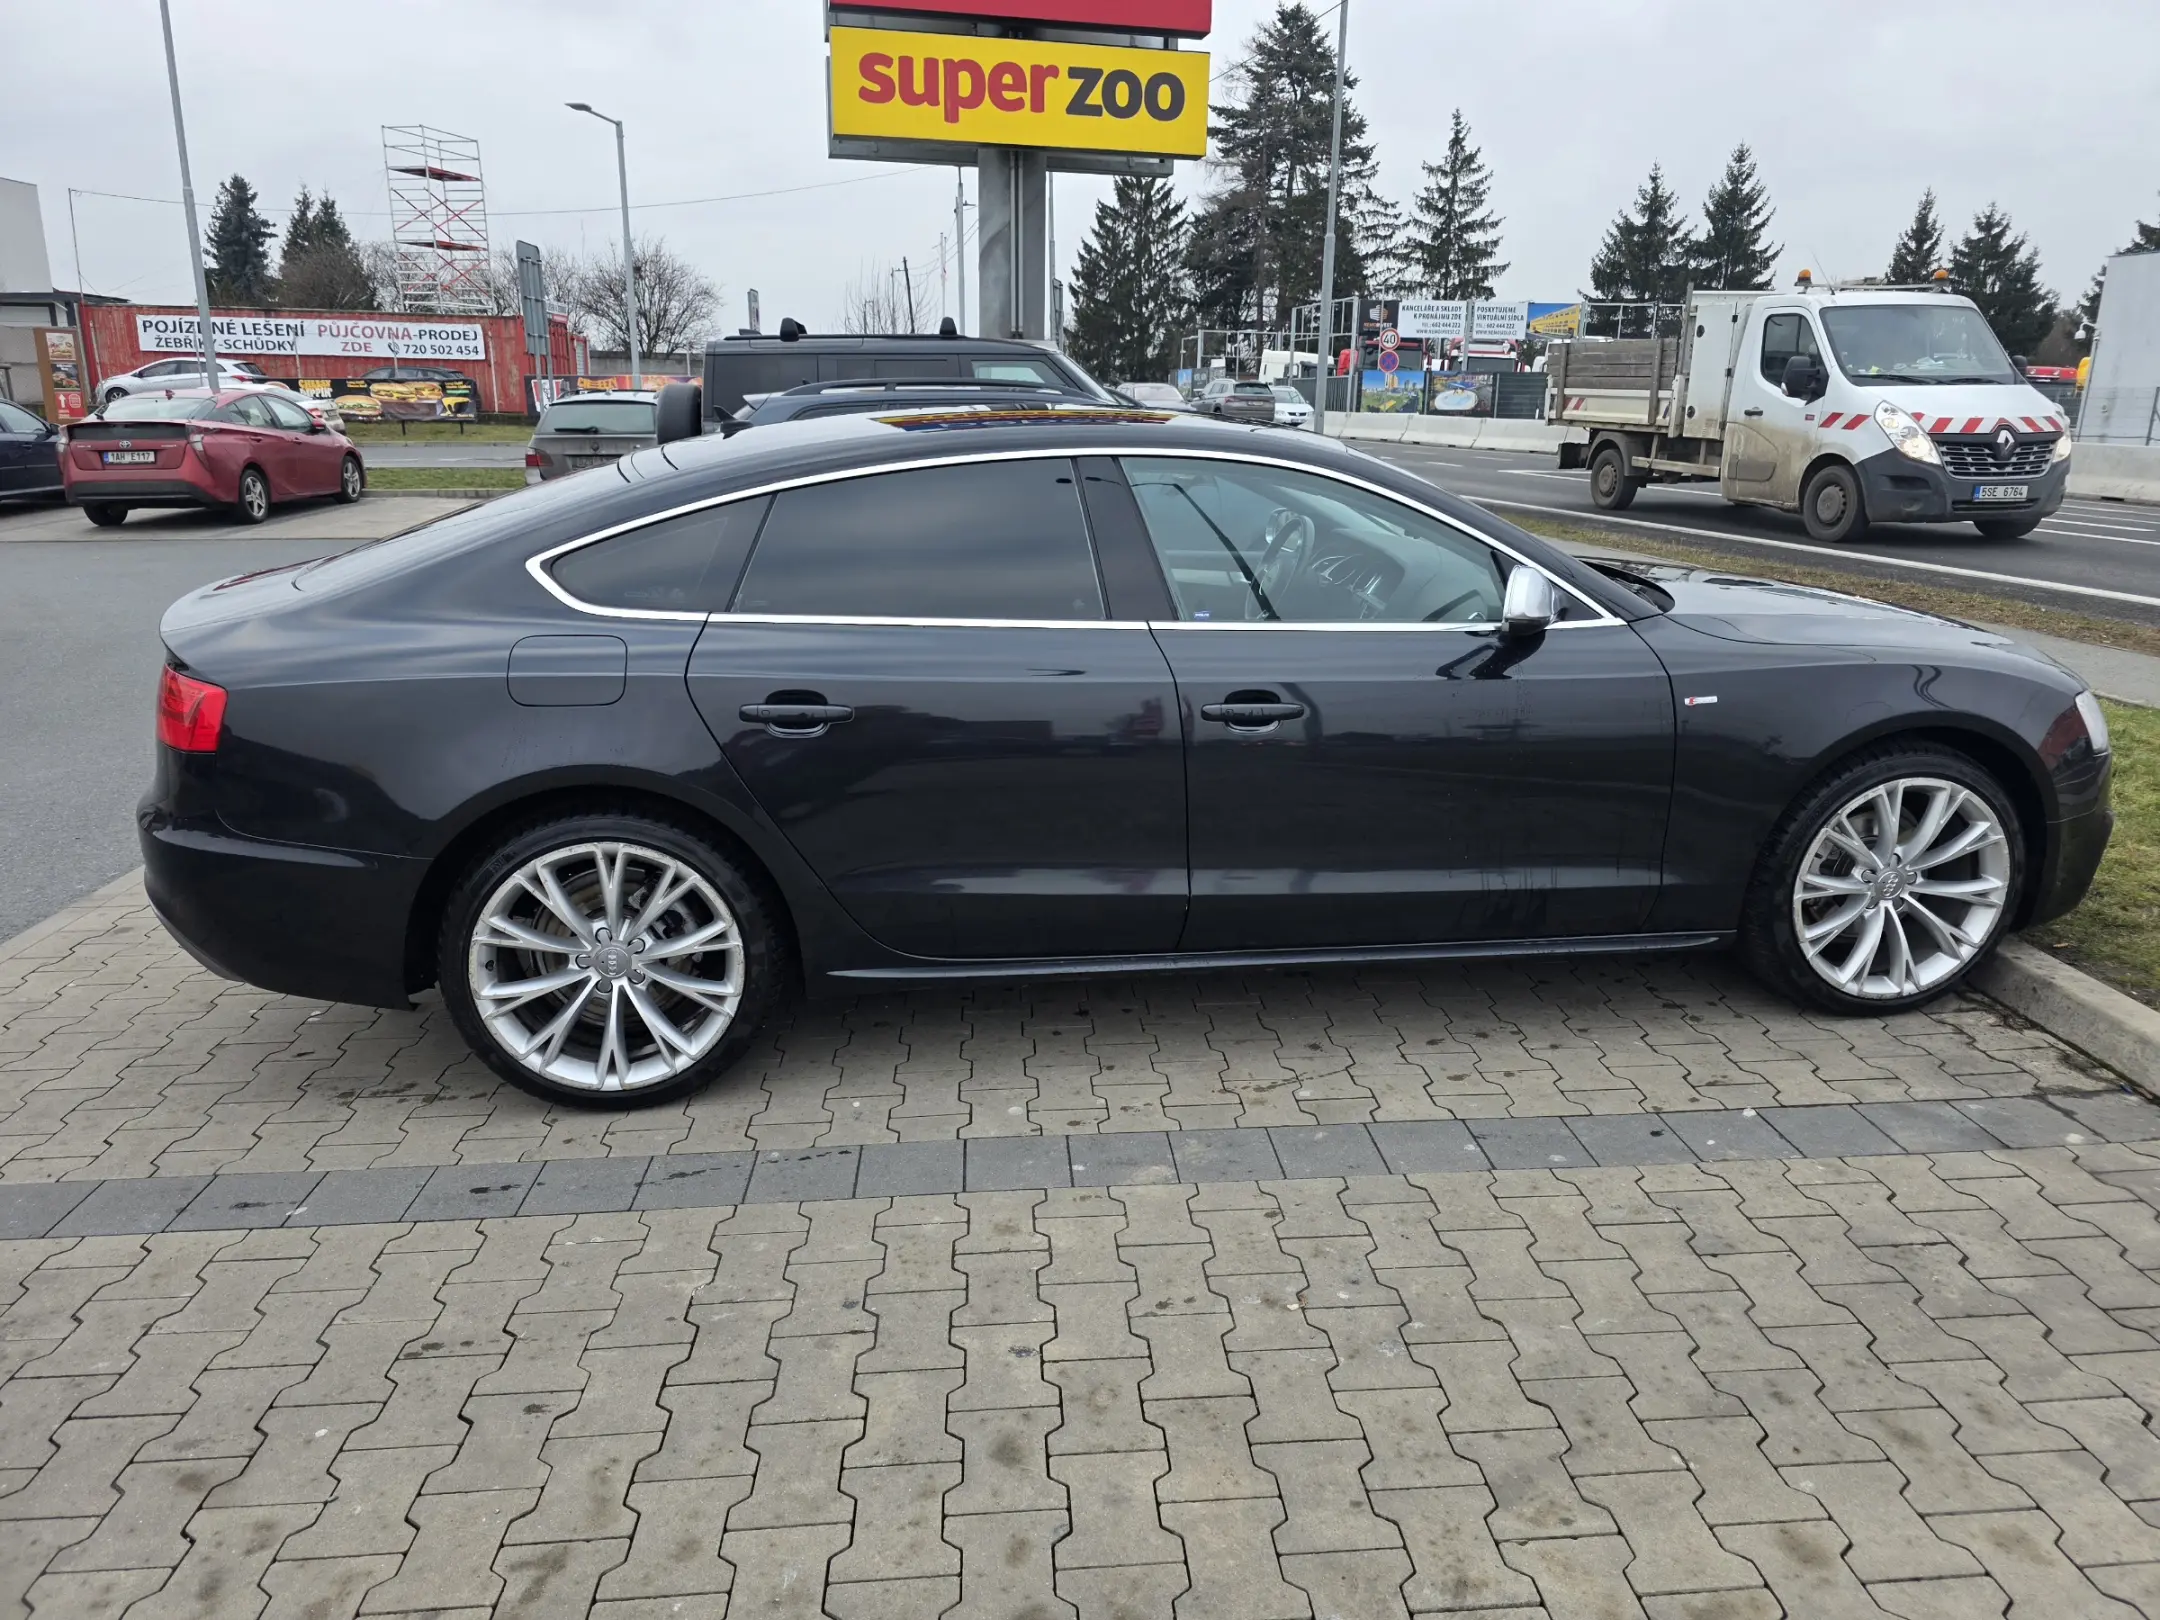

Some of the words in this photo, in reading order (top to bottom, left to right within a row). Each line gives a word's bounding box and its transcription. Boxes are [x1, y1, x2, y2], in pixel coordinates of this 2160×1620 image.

[858, 52, 1060, 124] super
[1065, 66, 1186, 122] zoo
[242, 320, 305, 337] LEŠENÍ
[1383, 334, 1396, 345] 40
[340, 341, 373, 353] ZDE
[403, 344, 427, 355] 720
[430, 344, 453, 355] 502
[456, 345, 479, 356] 454
[110, 452, 126, 461] 1AH
[131, 452, 151, 461] E117
[1981, 487, 1998, 497] 5SE
[2003, 487, 2024, 497] 6764
